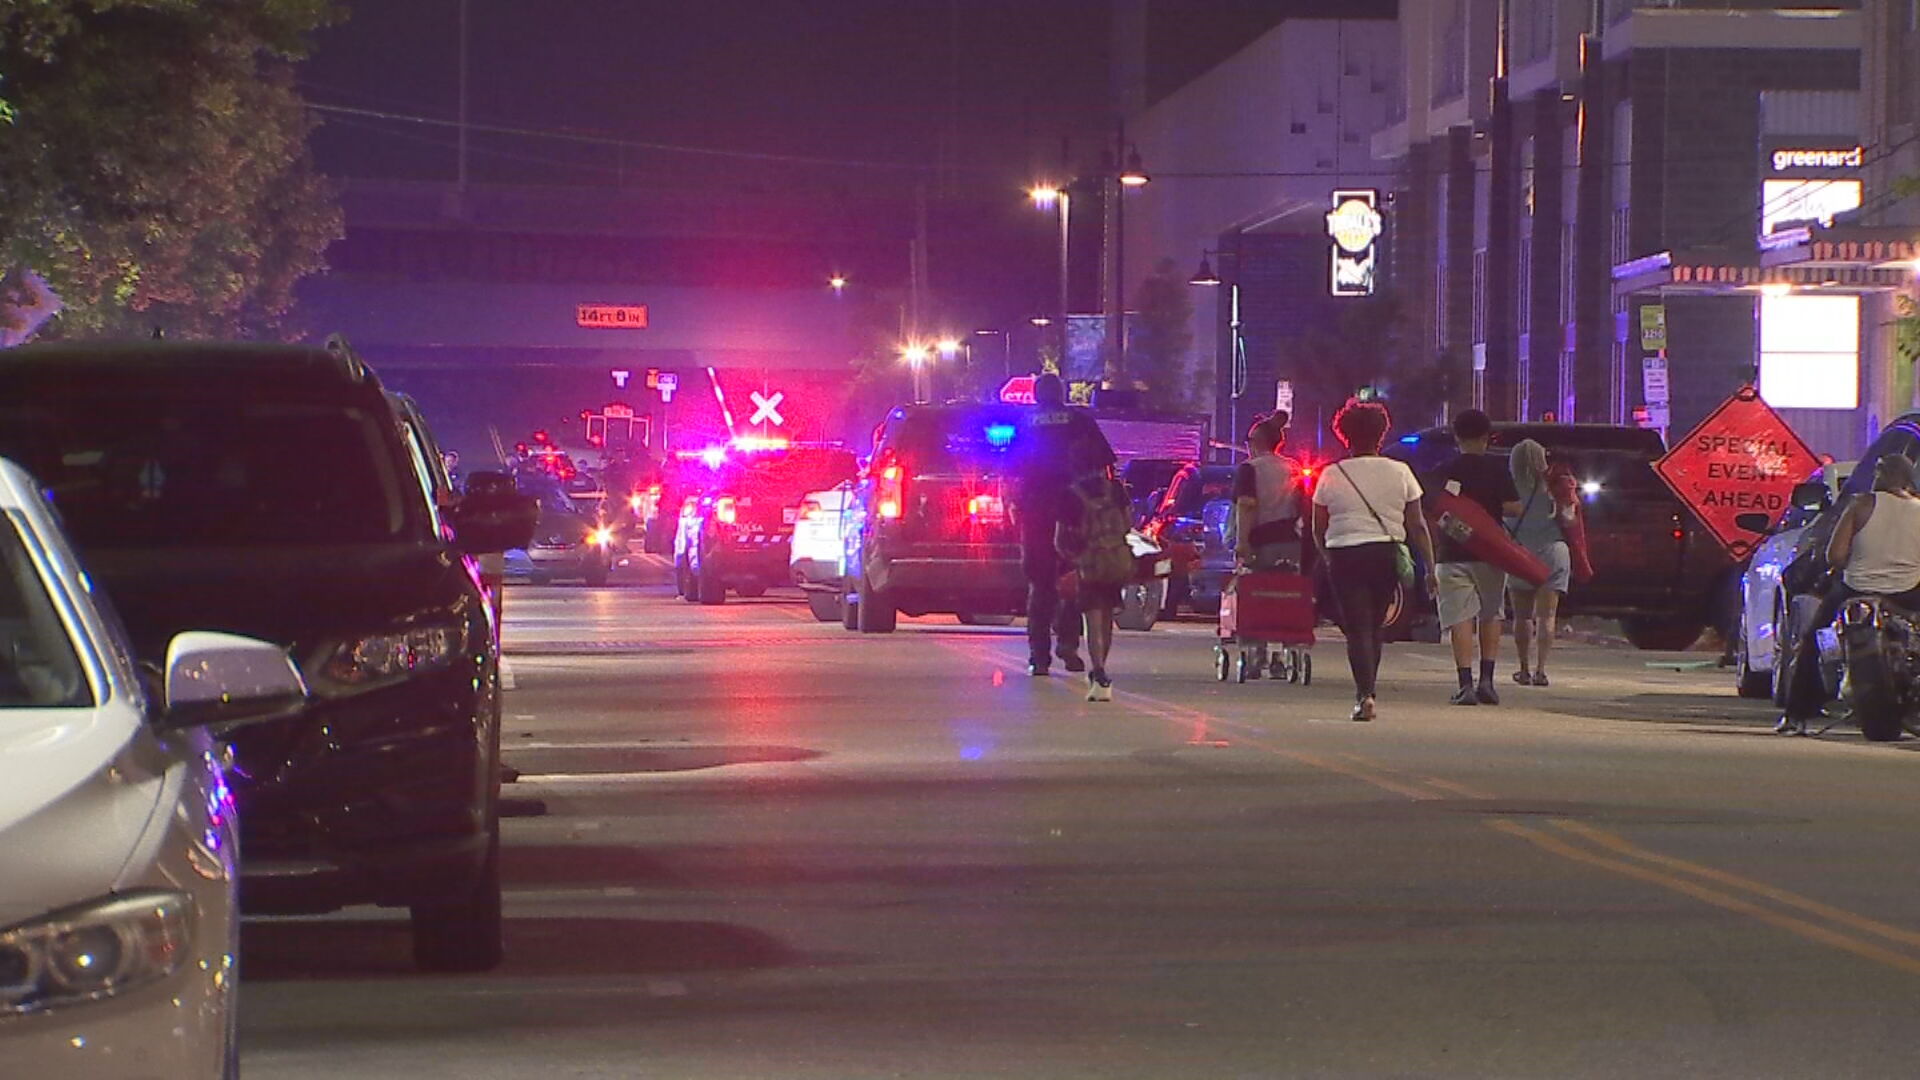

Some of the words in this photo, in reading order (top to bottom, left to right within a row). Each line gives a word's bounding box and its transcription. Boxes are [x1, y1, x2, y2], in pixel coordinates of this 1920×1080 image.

[1033, 412, 1069, 424] POLICE
[1698, 436, 1793, 457] SPECIAL
[1708, 463, 1781, 482] EVENT
[1702, 490, 1782, 510] AHEAD
[735, 522, 764, 532] TULSA
